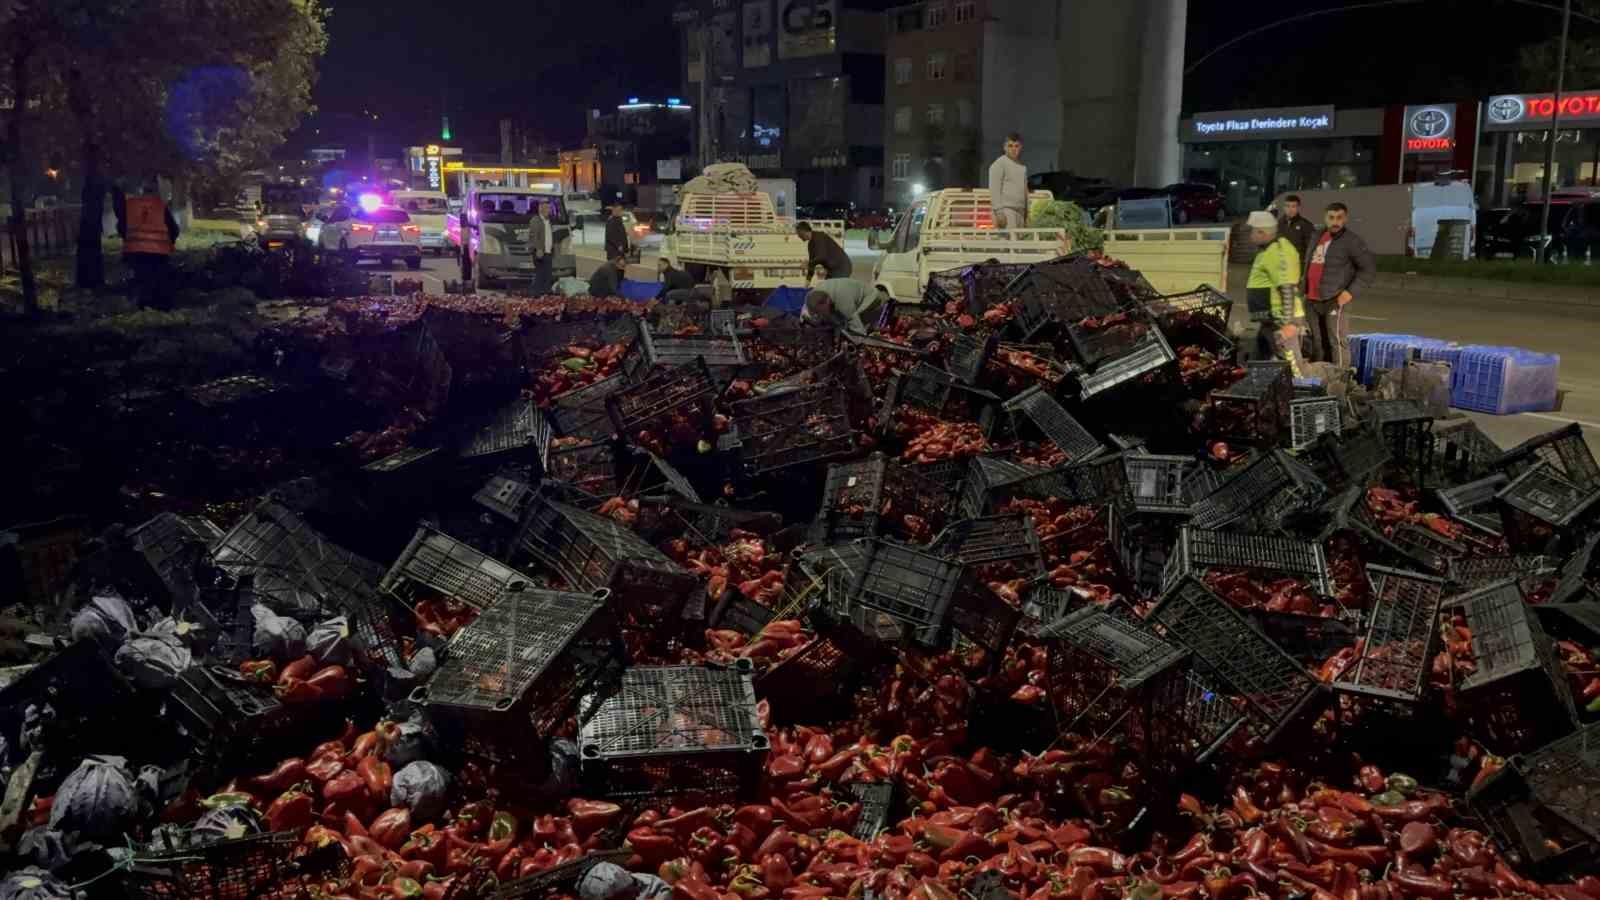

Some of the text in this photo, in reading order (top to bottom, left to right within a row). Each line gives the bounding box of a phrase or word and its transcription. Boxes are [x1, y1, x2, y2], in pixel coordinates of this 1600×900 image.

[1527, 97, 1600, 116] TOYOT
[1196, 122, 1224, 134] Toyota
[1226, 120, 1249, 131] Plaza
[1299, 115, 1329, 129] Koçak
[1407, 138, 1450, 150] TOYOTA
